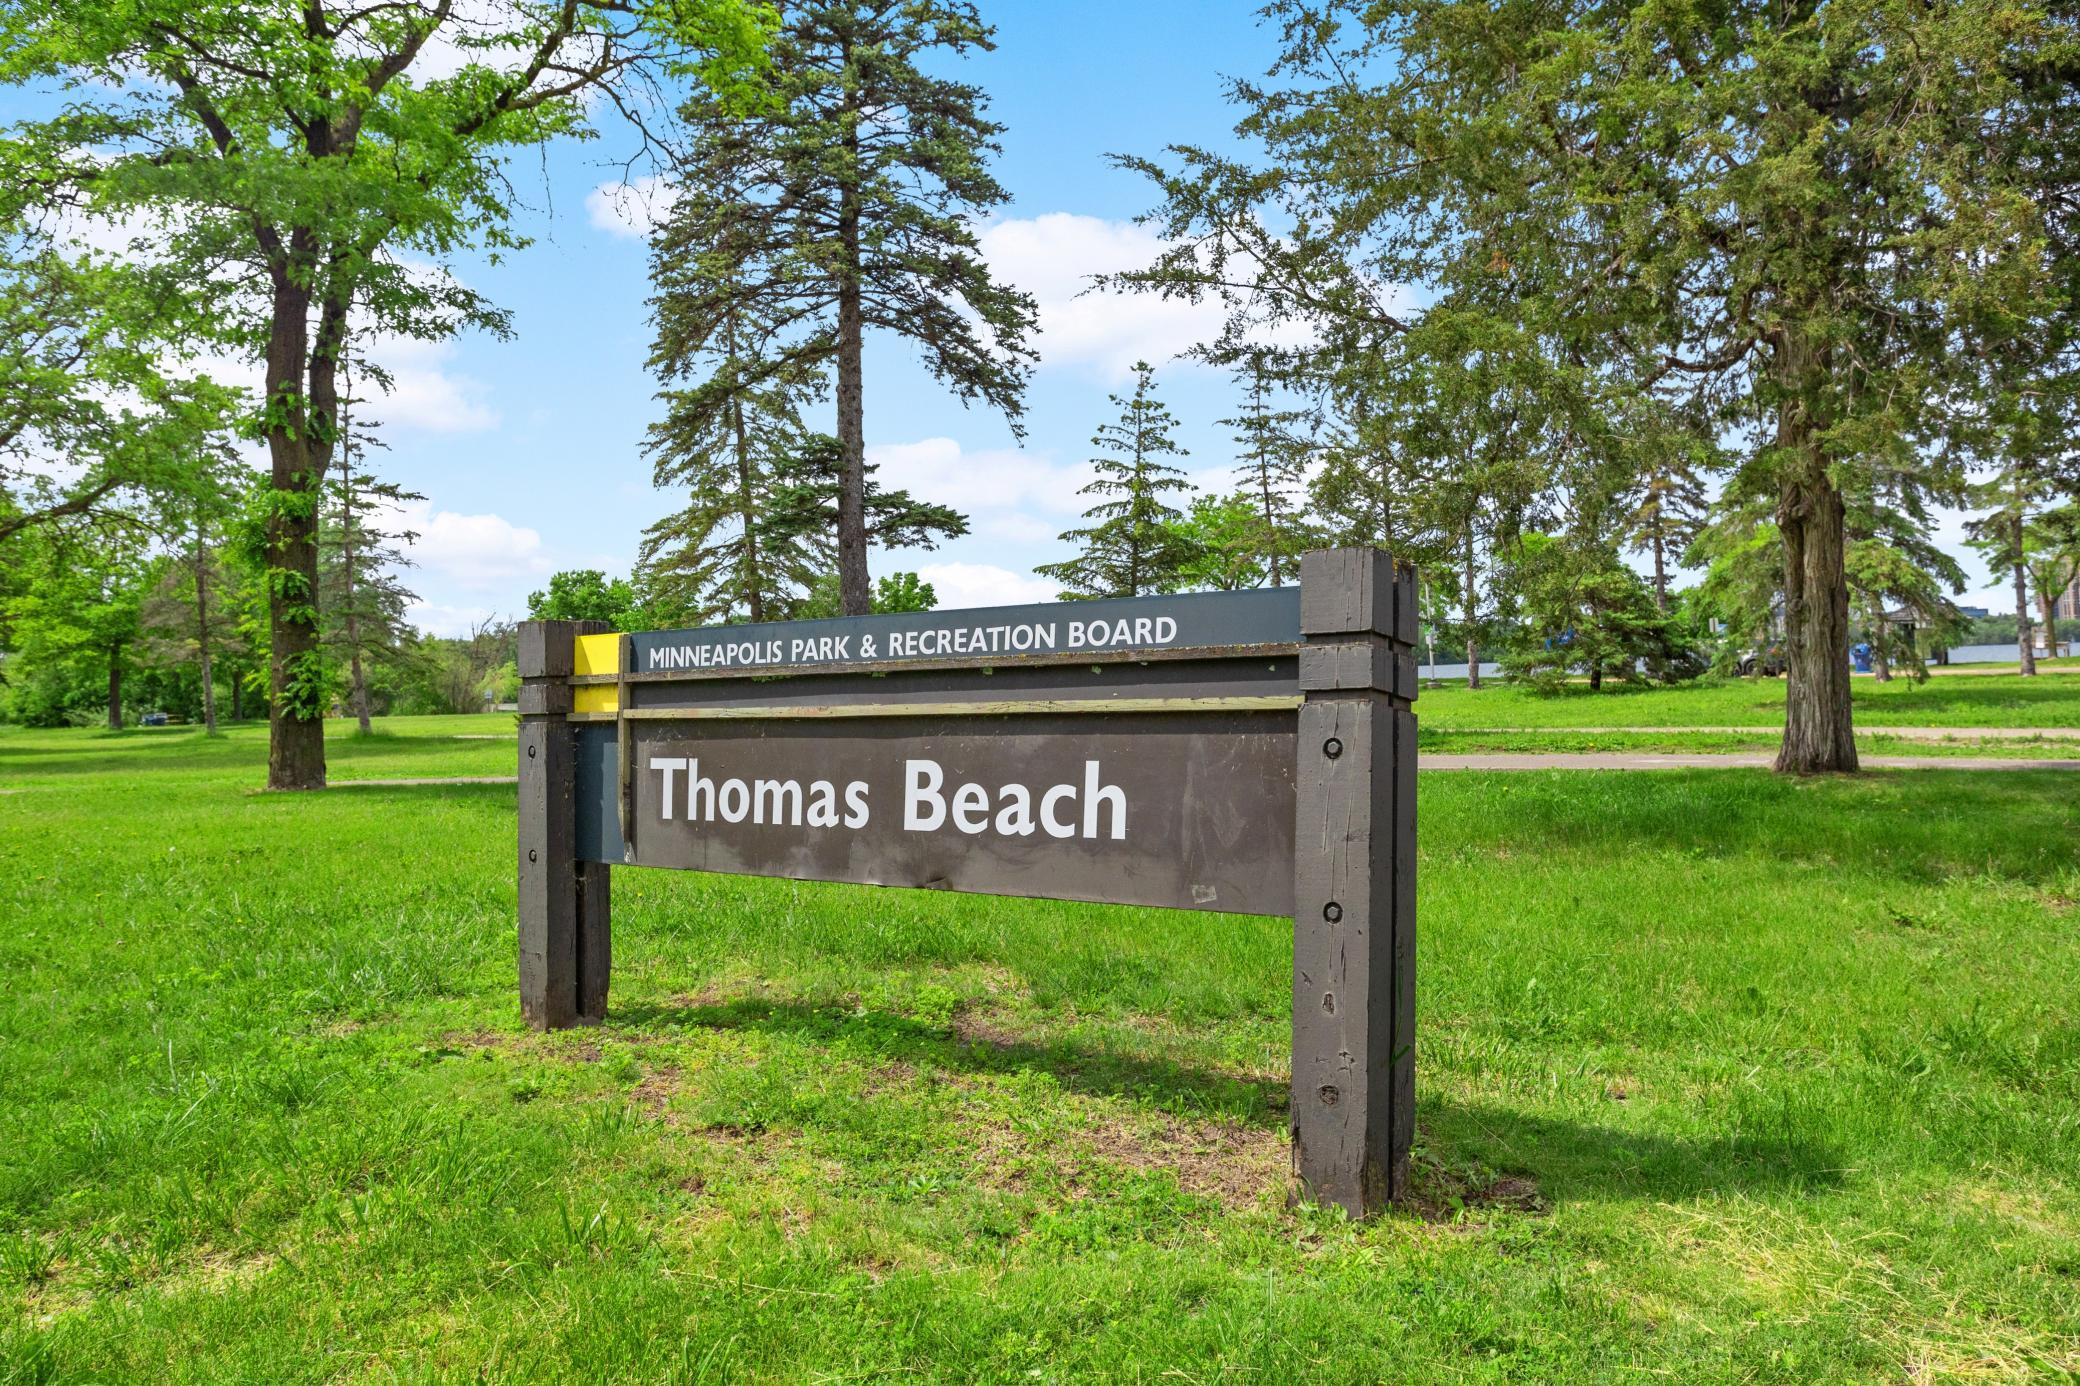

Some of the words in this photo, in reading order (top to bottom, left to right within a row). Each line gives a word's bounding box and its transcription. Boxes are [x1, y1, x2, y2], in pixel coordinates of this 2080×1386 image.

[649, 639, 783, 669] MINNEAPOLIS
[791, 635, 850, 662] PARK
[859, 634, 878, 657] &
[888, 622, 1056, 657] RECREATION
[1068, 616, 1178, 648] BOARD
[649, 757, 870, 830] Thomas
[903, 759, 1127, 840] Beach
